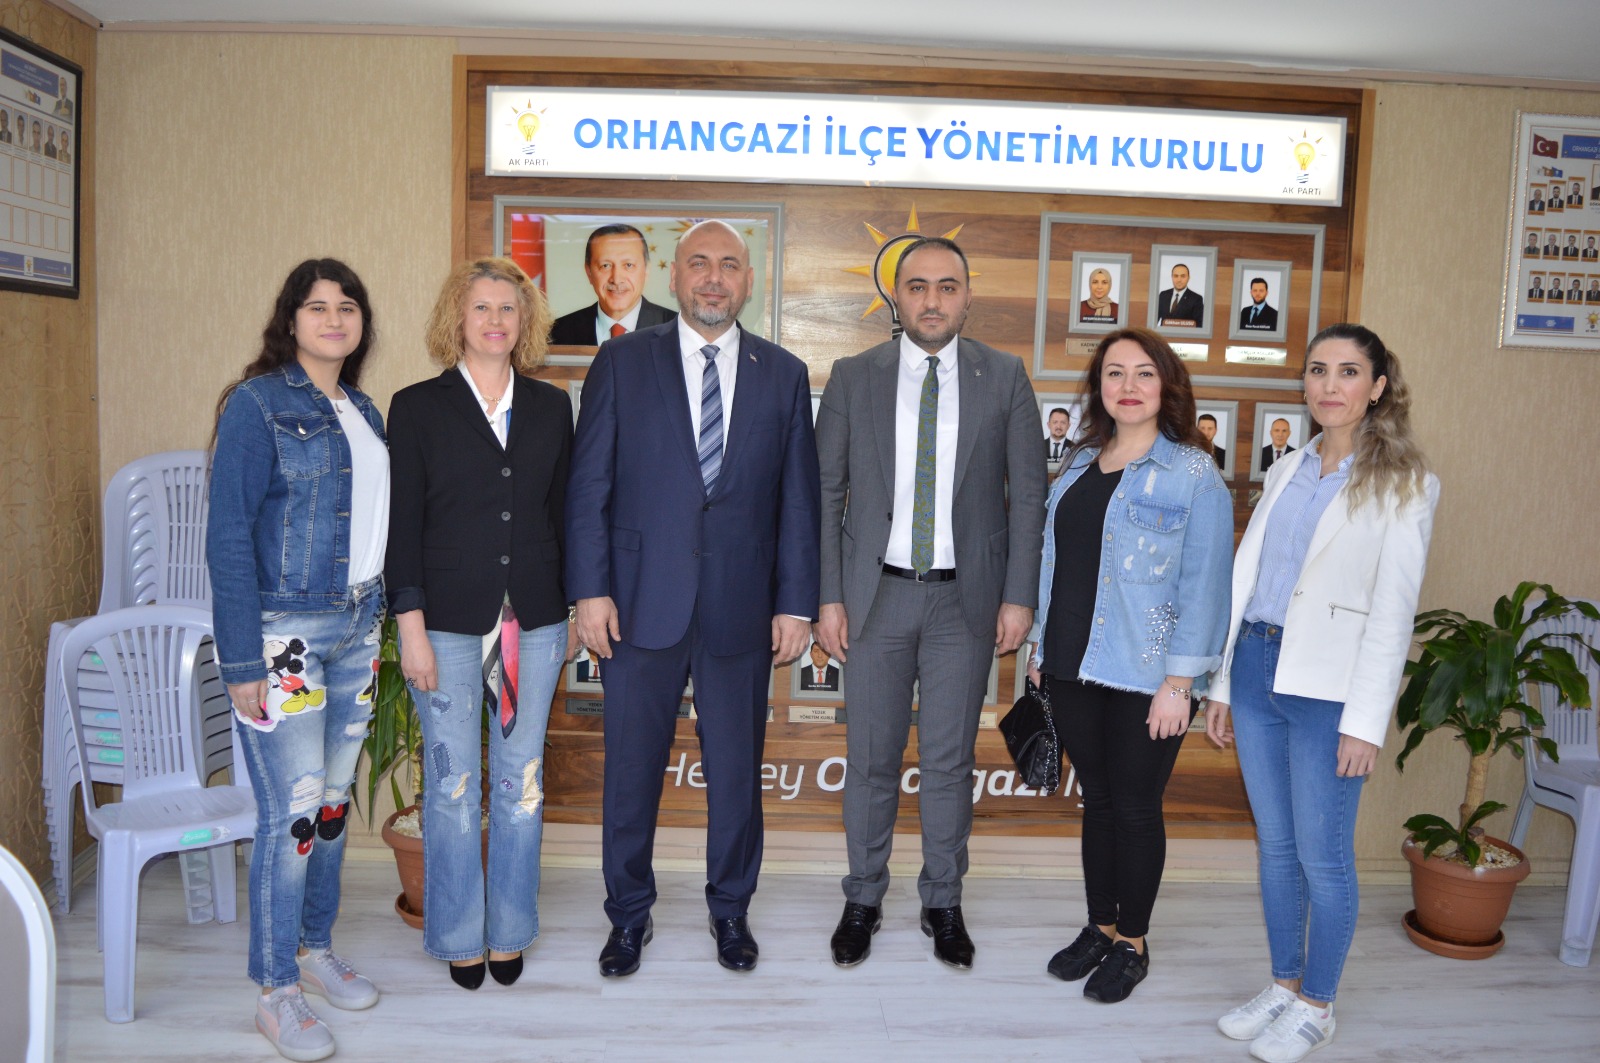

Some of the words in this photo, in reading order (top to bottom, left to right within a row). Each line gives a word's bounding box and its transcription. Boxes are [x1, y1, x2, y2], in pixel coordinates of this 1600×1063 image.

[573, 114, 811, 154] ORHANGAZİ
[824, 115, 907, 166] İLÇE
[916, 119, 1098, 165] YÖNETİM
[1111, 136, 1264, 173] KURULU
[508, 158, 521, 166] AK
[1282, 186, 1294, 194] AK
